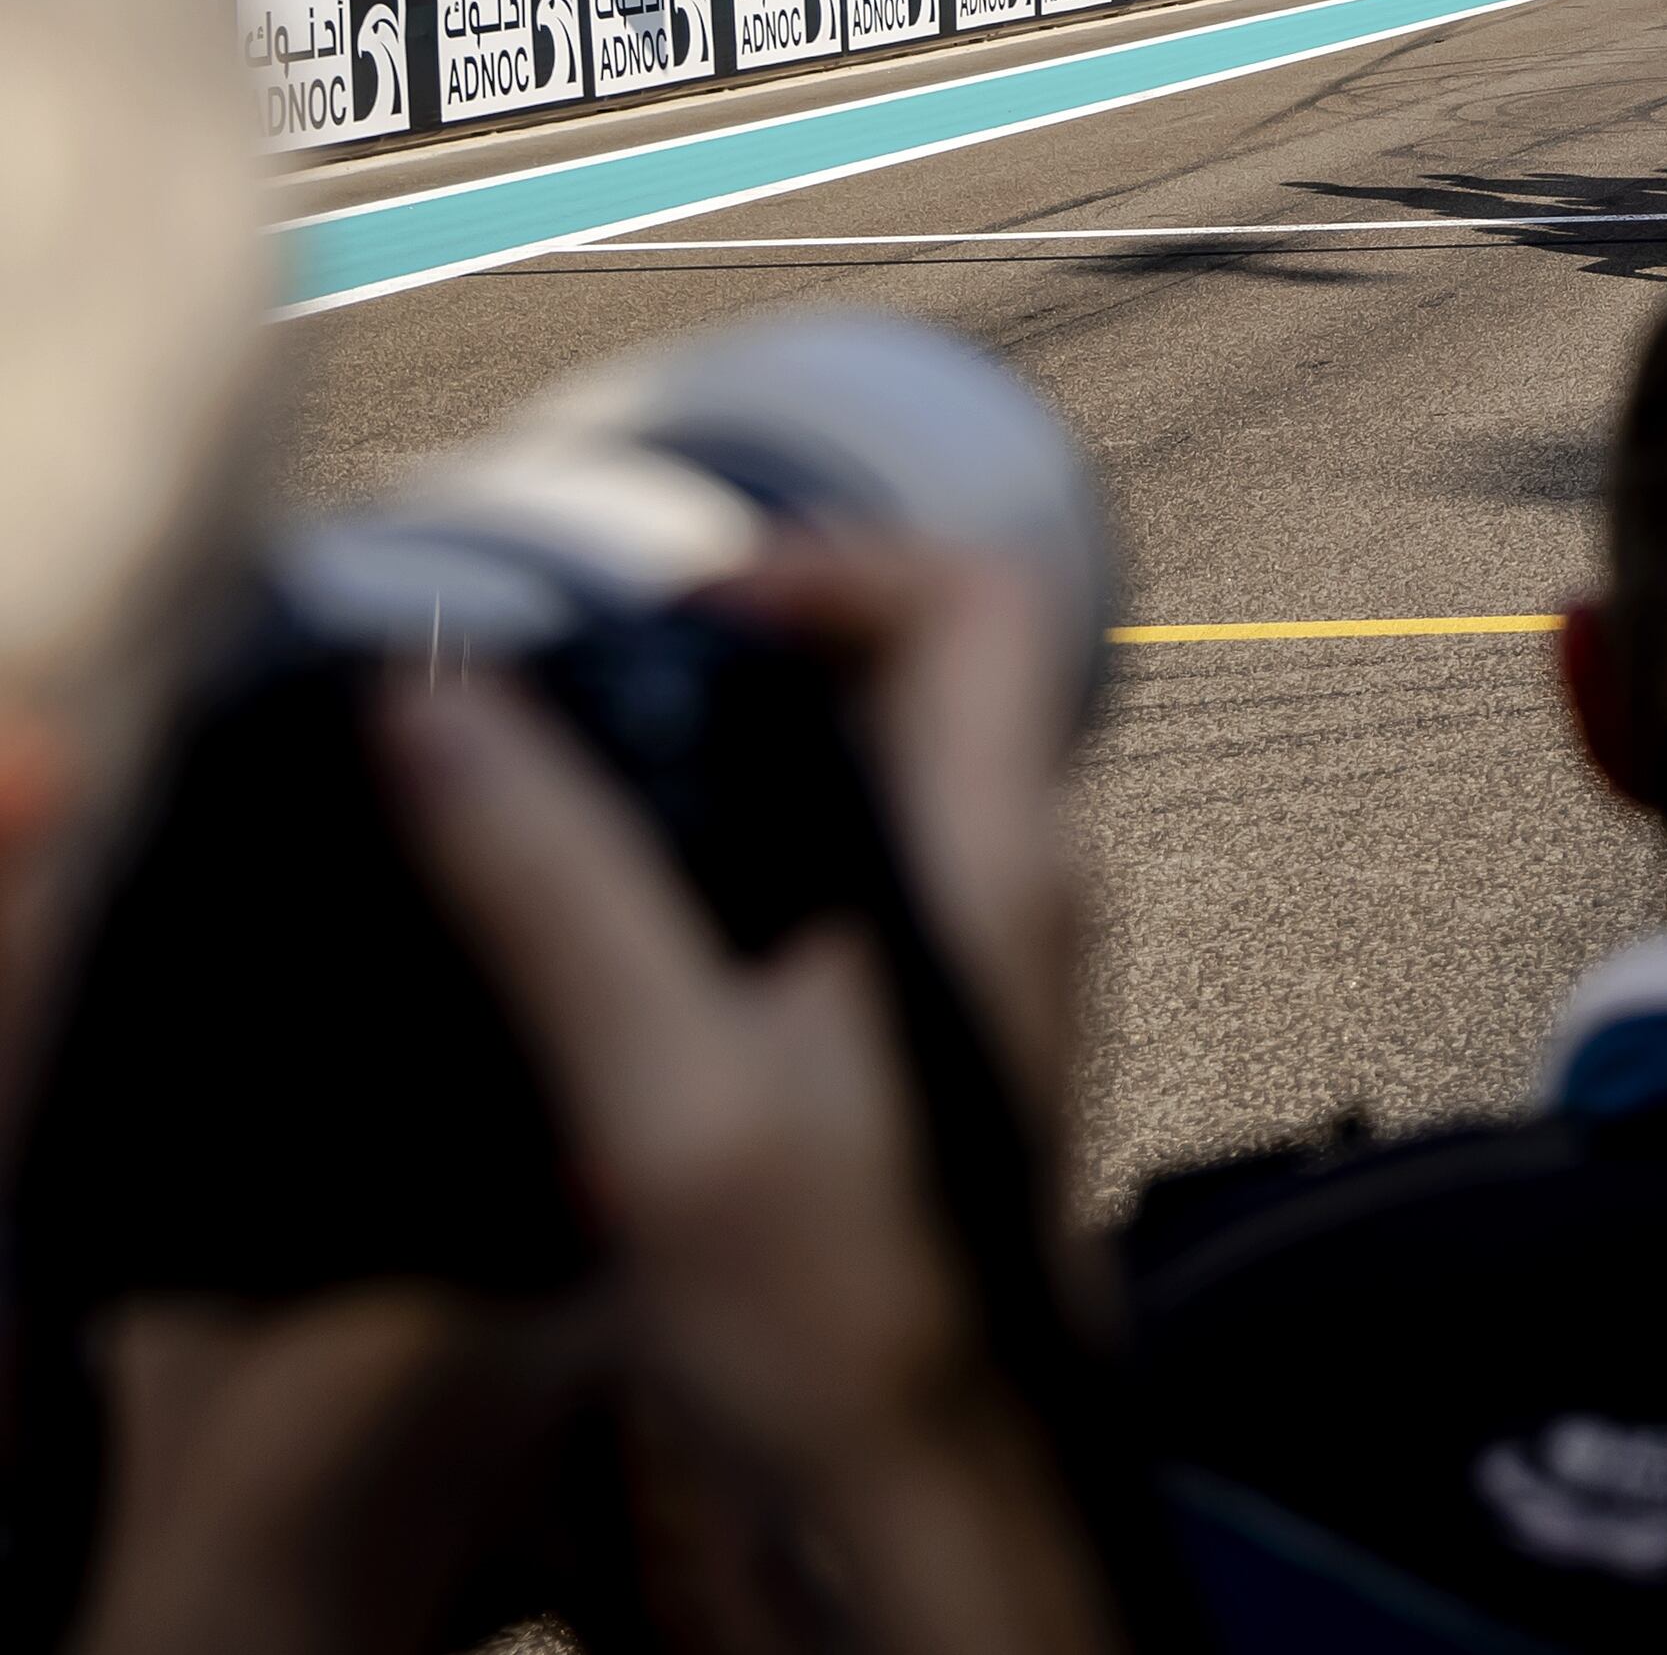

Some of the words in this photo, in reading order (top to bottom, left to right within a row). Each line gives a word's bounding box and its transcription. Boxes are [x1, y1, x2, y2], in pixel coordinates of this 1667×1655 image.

[600, 27, 668, 81] ADNOC
[741, 7, 802, 56] ADNOC
[447, 46, 529, 105] ADNOC
